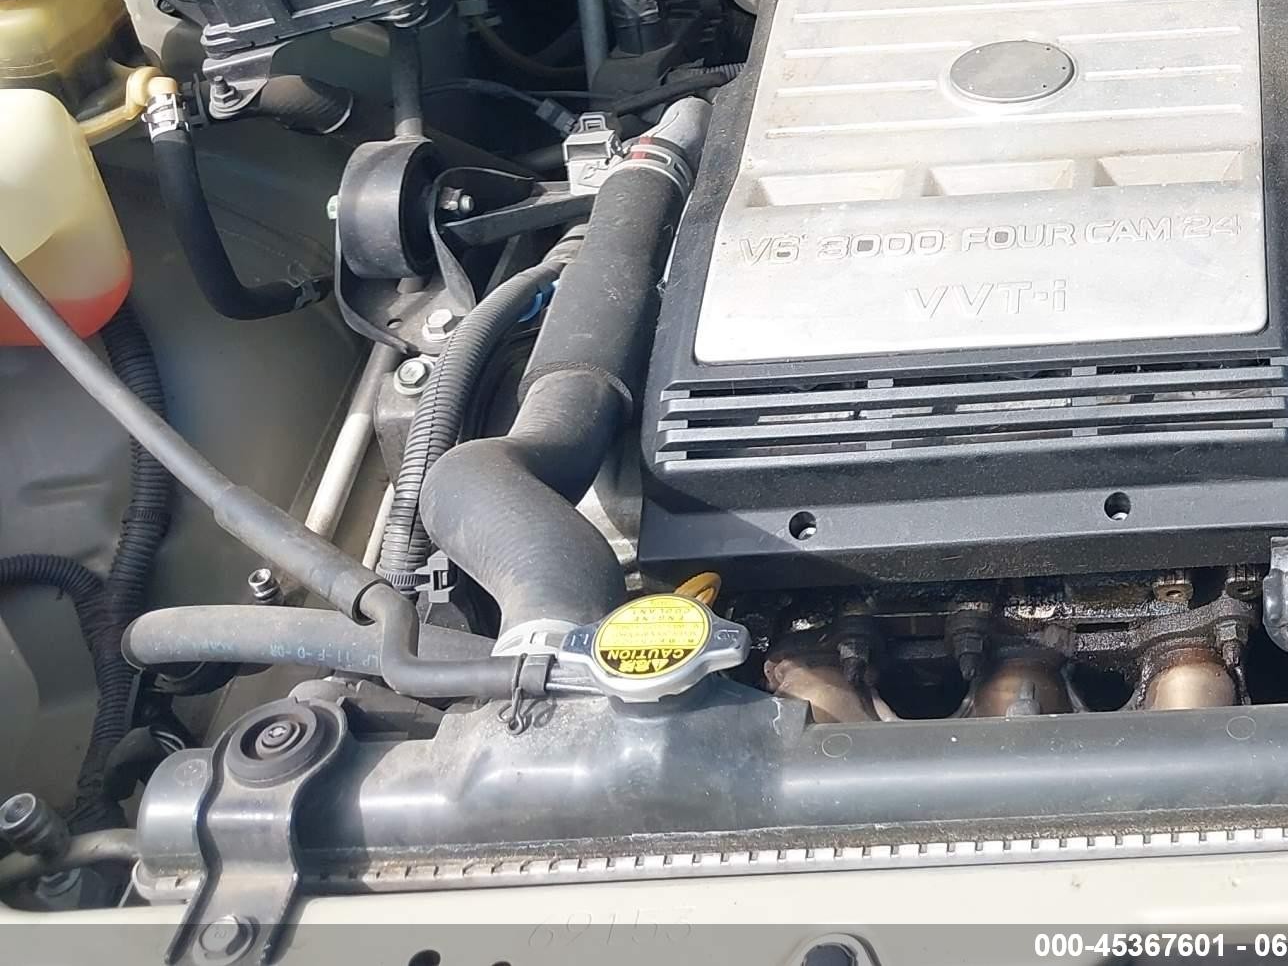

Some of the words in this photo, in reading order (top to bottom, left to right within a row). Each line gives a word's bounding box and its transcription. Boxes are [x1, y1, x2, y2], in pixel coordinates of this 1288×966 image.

[738, 233, 801, 266] V6
[816, 228, 945, 261] 3000
[960, 221, 1078, 252] FOUR
[1085, 217, 1173, 244] CAM
[1182, 213, 1242, 240] 24
[905, 278, 1067, 320] VVT-i
[607, 649, 685, 661] CAUTION
